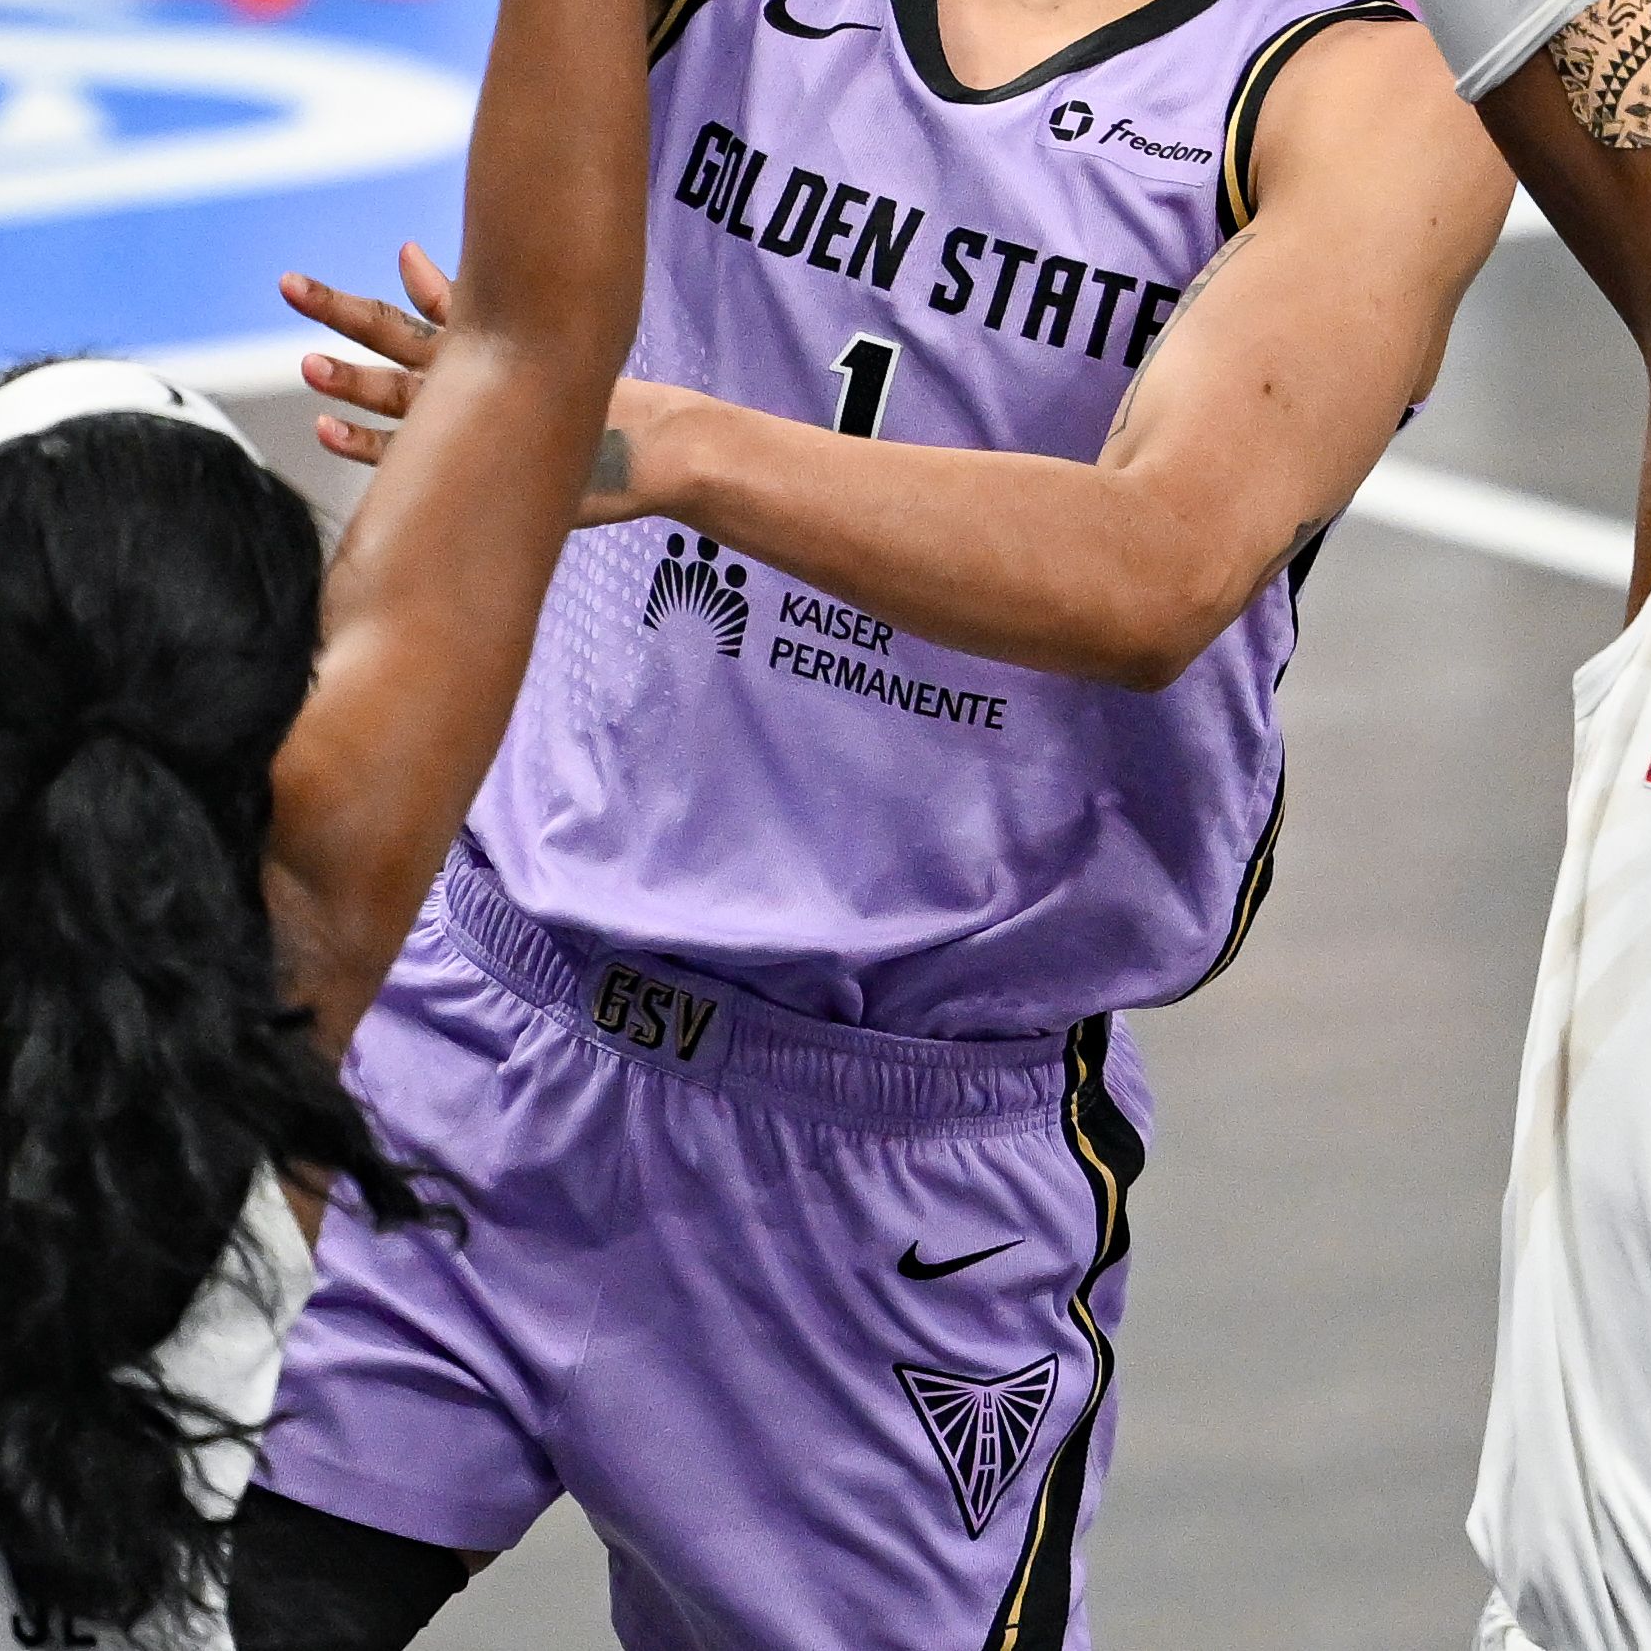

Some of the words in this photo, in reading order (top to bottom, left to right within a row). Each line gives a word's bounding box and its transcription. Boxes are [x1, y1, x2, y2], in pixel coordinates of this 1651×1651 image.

[1098, 118, 1213, 166] freedom
[674, 120, 925, 291] GOLDEN
[928, 227, 1182, 370] STATE
[779, 591, 894, 656] KAISER
[769, 641, 1007, 730] PERMANENTE
[591, 961, 719, 1061] GSV
